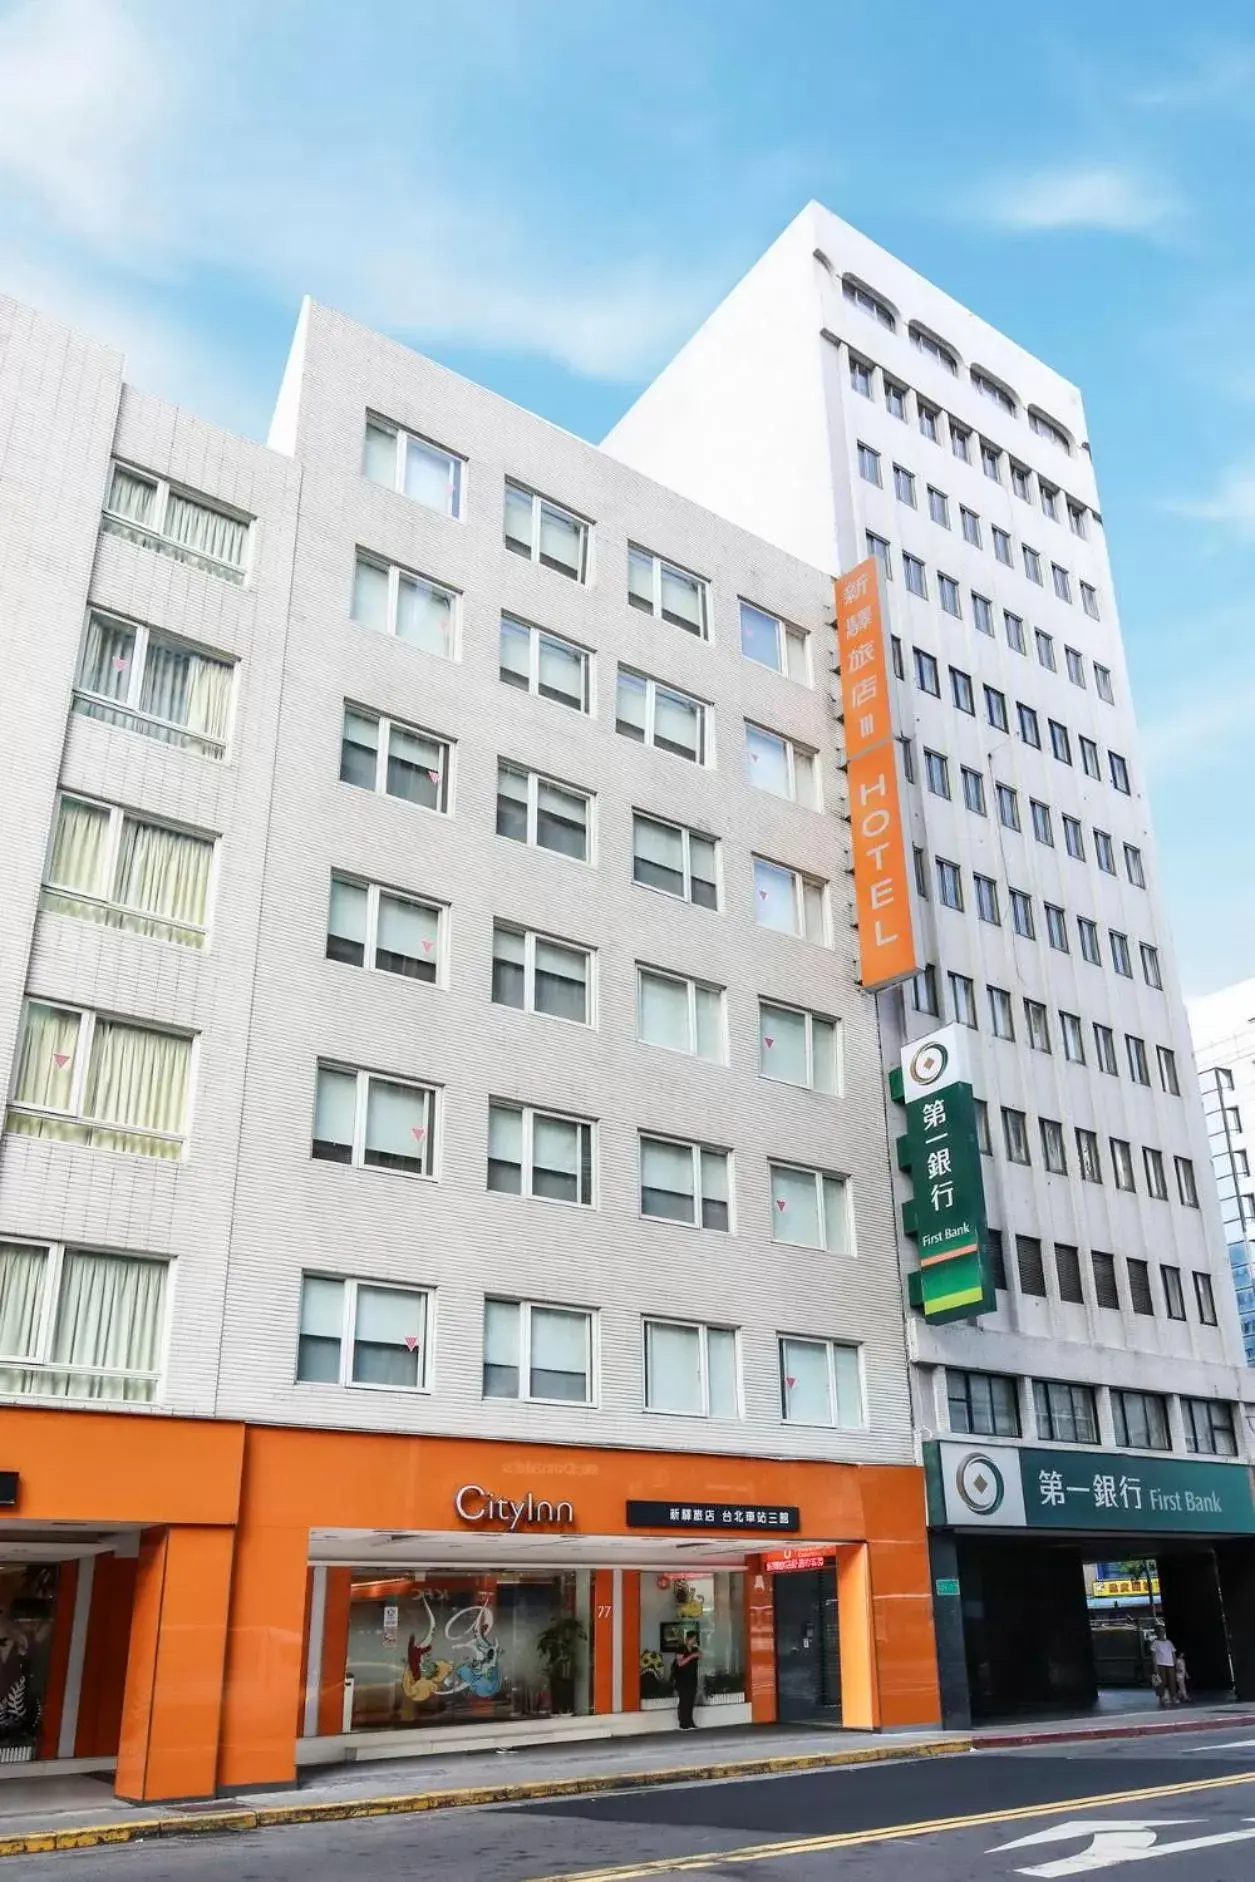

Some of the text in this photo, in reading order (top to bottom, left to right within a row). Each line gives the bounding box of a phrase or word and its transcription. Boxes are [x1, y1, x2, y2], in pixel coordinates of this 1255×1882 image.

[843, 573, 877, 709] 新驛旅店
[860, 772, 898, 946] HOTEL
[922, 1099, 955, 1212] 第一銀行
[922, 1221, 970, 1247] First Bank
[456, 1484, 574, 1530] CityInn
[1038, 1469, 1222, 1513] 第一銀行 First Bank
[669, 1508, 715, 1522] 新驛旅店
[597, 1605, 611, 1618] 77
